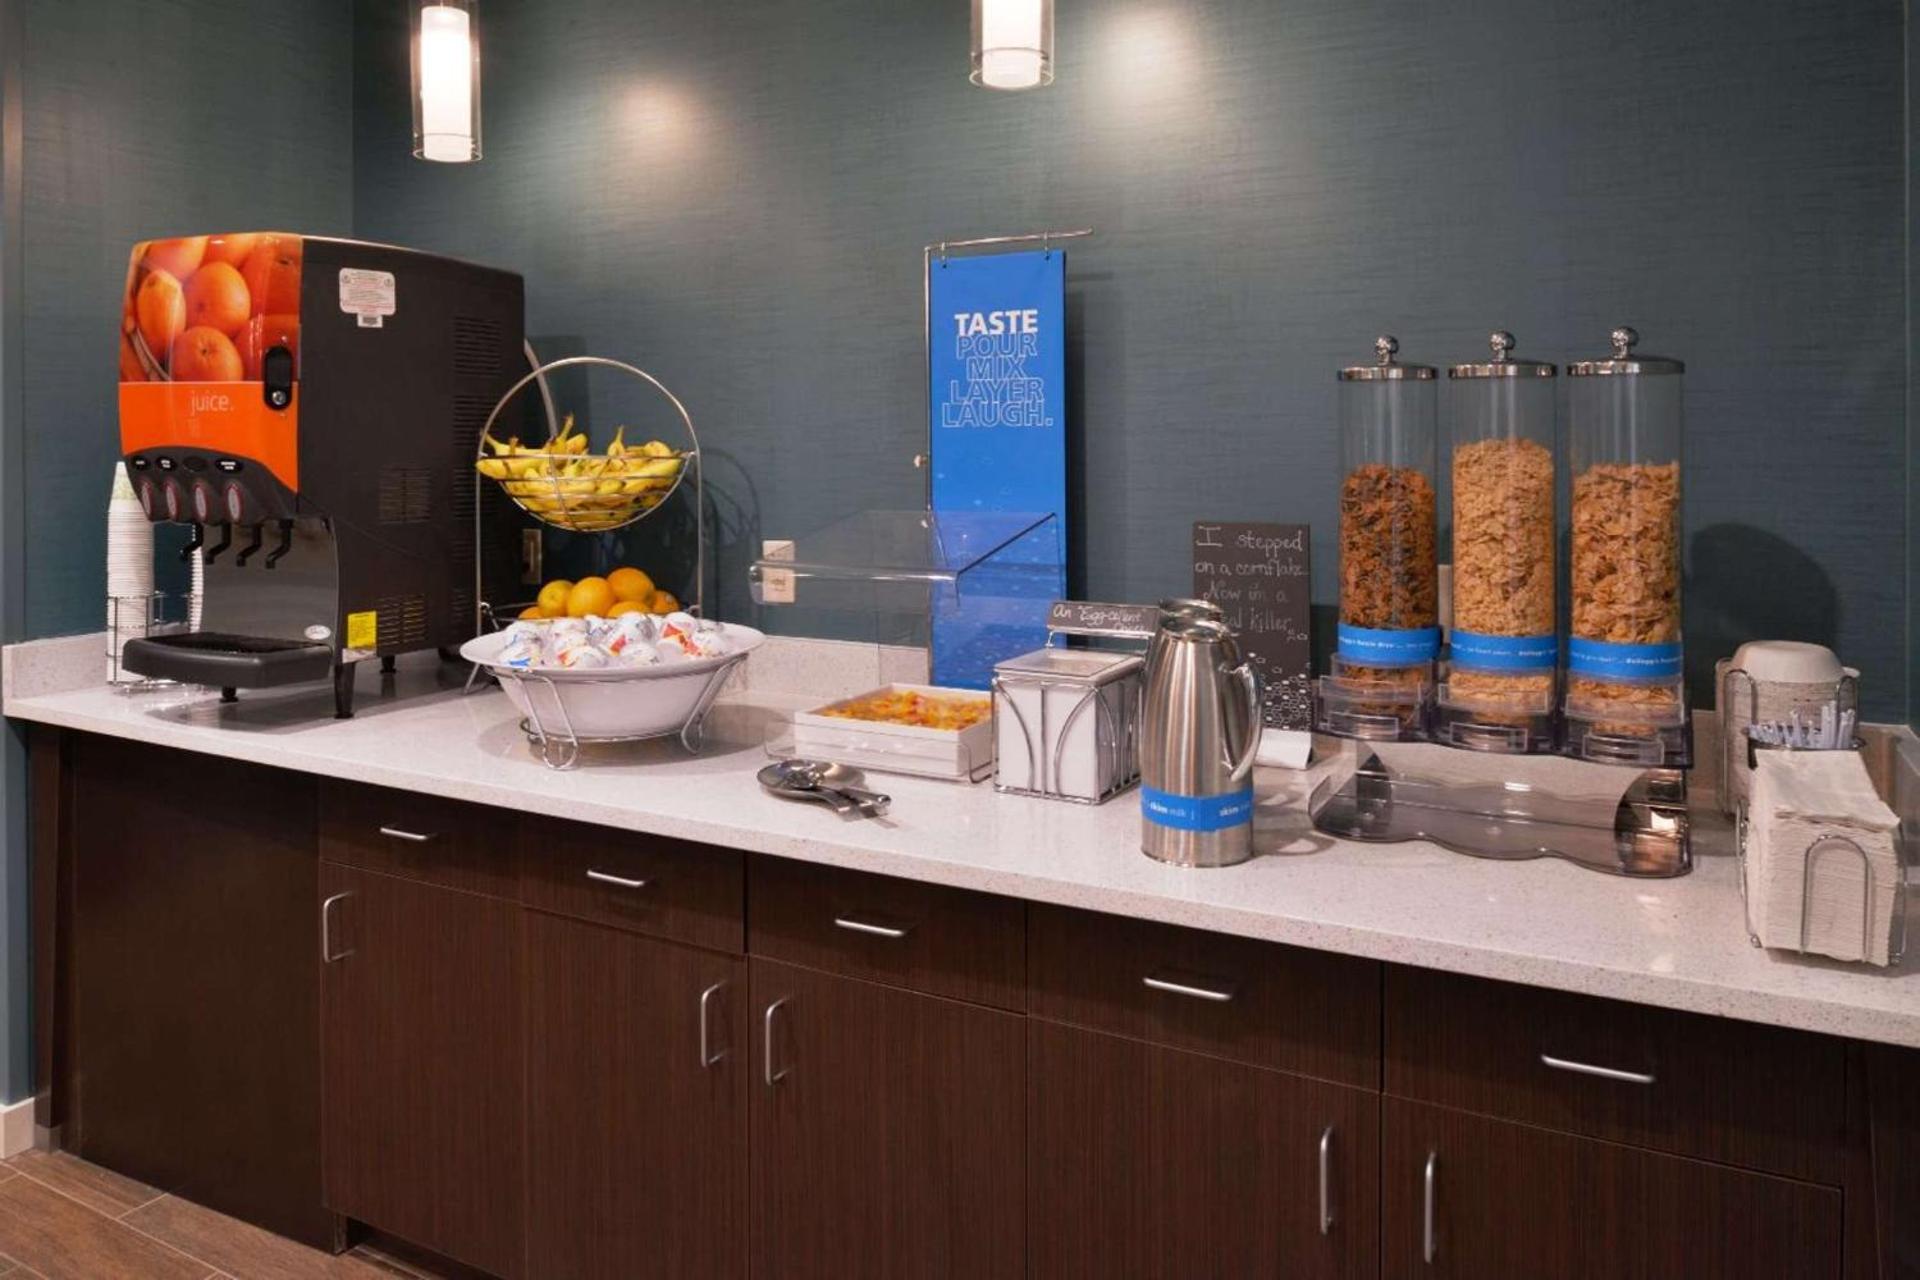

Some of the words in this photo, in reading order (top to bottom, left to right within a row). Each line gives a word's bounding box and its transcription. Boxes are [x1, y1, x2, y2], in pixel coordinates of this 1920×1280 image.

[954, 309, 1038, 336] TASTE
[956, 331, 1038, 359] POUR
[966, 356, 1026, 381] MIX
[950, 377, 1044, 404] LAYER
[942, 400, 1054, 427] LAUGH.
[1196, 525, 1223, 547] I
[1237, 529, 1303, 557] stepped
[1194, 561, 1216, 575] on
[1220, 564, 1232, 577] a
